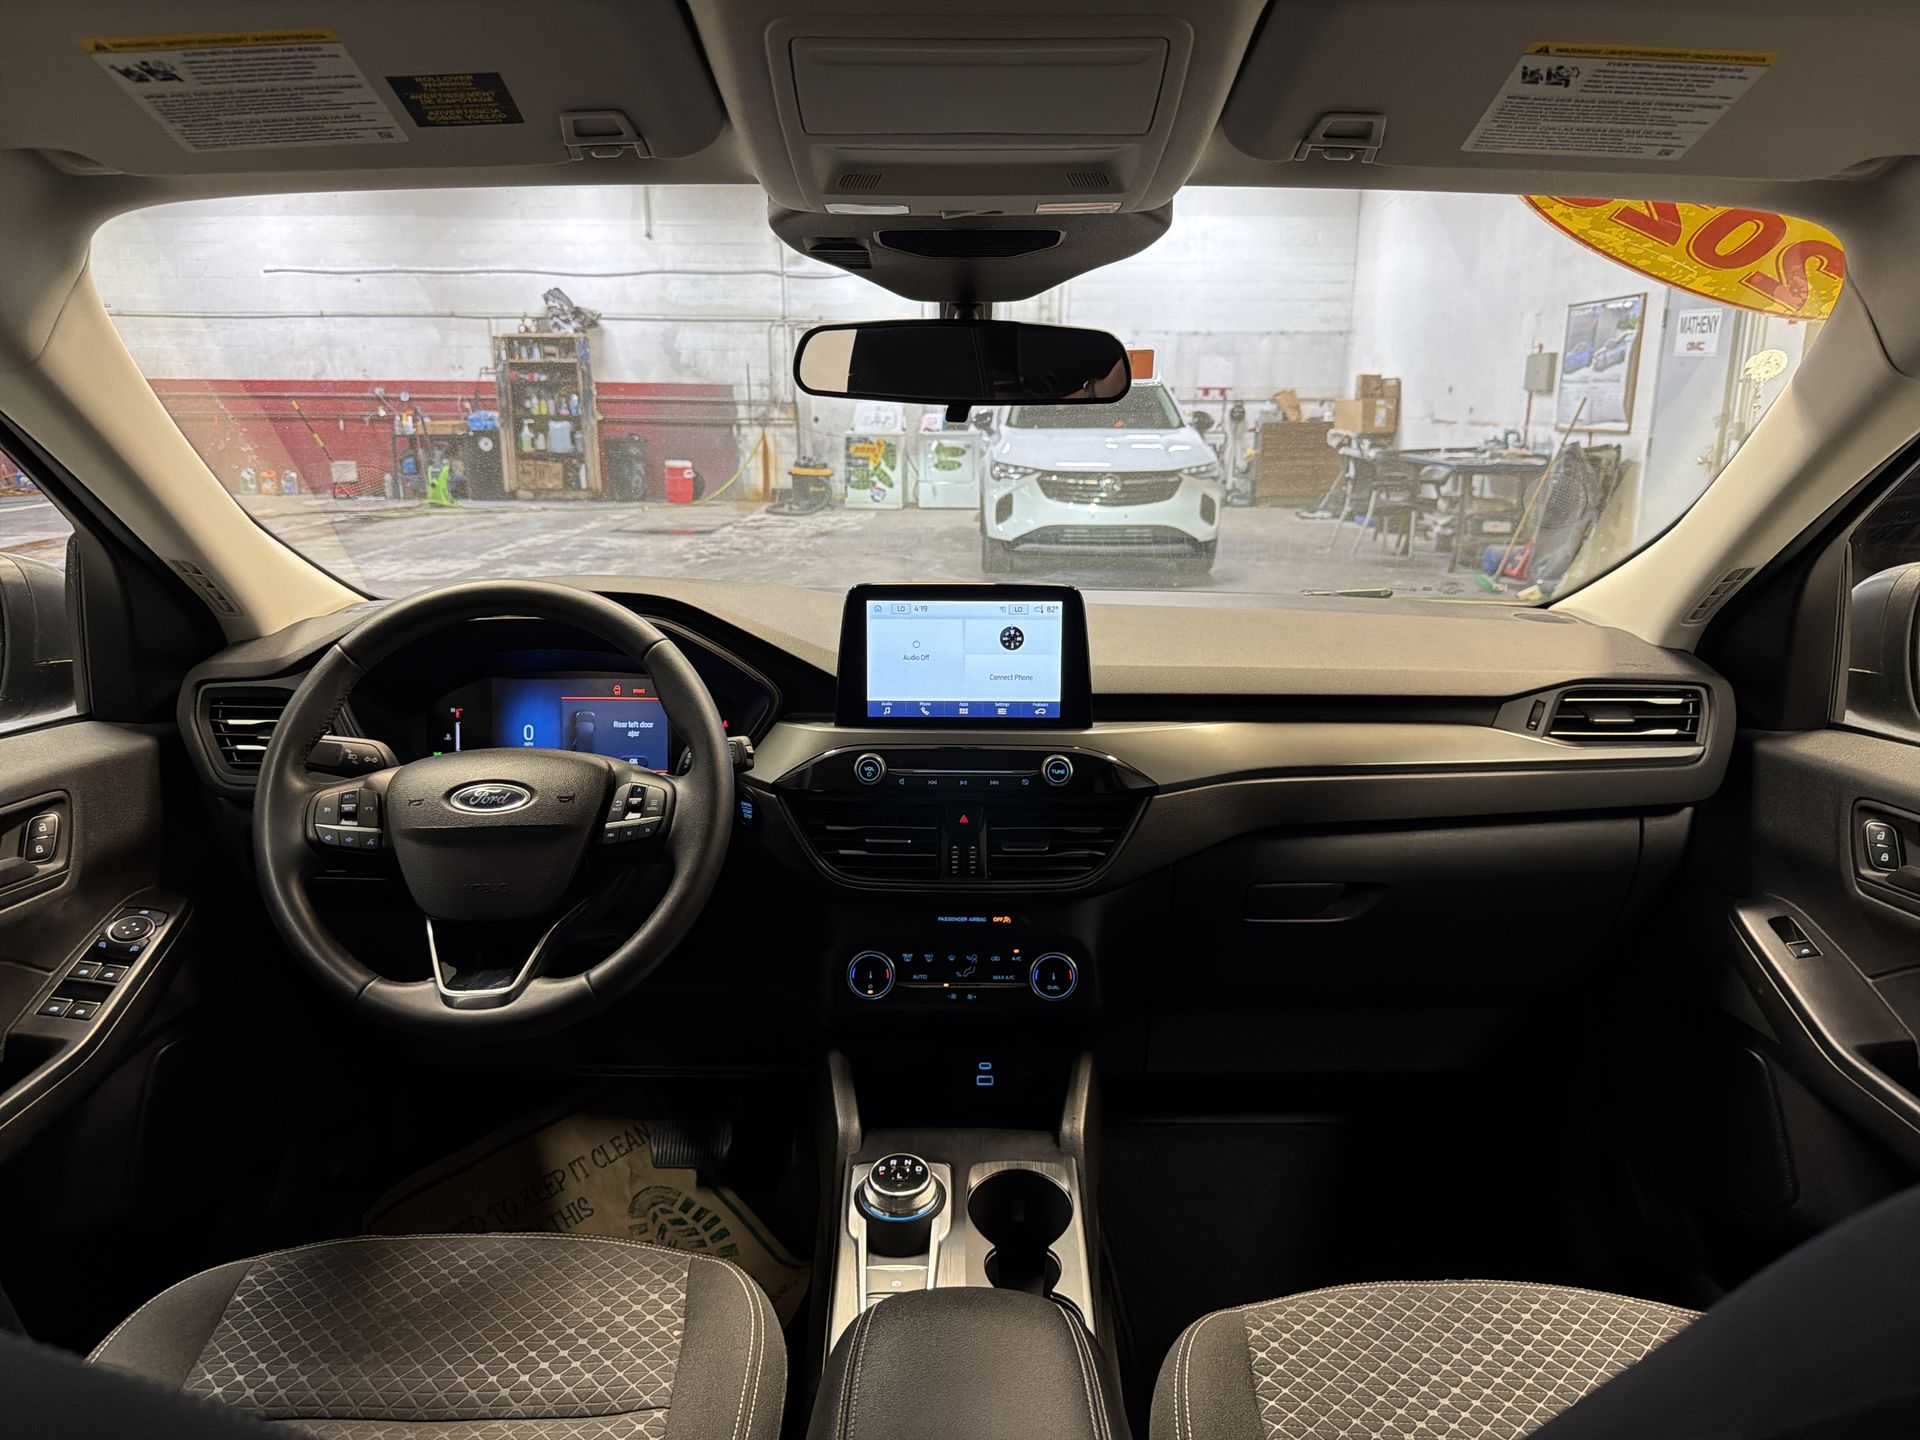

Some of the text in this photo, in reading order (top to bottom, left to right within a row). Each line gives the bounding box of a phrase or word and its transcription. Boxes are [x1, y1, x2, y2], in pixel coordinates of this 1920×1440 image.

[1680, 315, 1720, 334] MATHENY
[523, 724, 534, 741] 0
[613, 720, 654, 729] Rear left door
[628, 730, 640, 738] ajar
[469, 788, 511, 805] Ford
[518, 1169, 566, 1208] KEEP
[568, 1156, 590, 1183] IT
[591, 1122, 653, 1169] CLEAN
[544, 1197, 594, 1233] THIS
